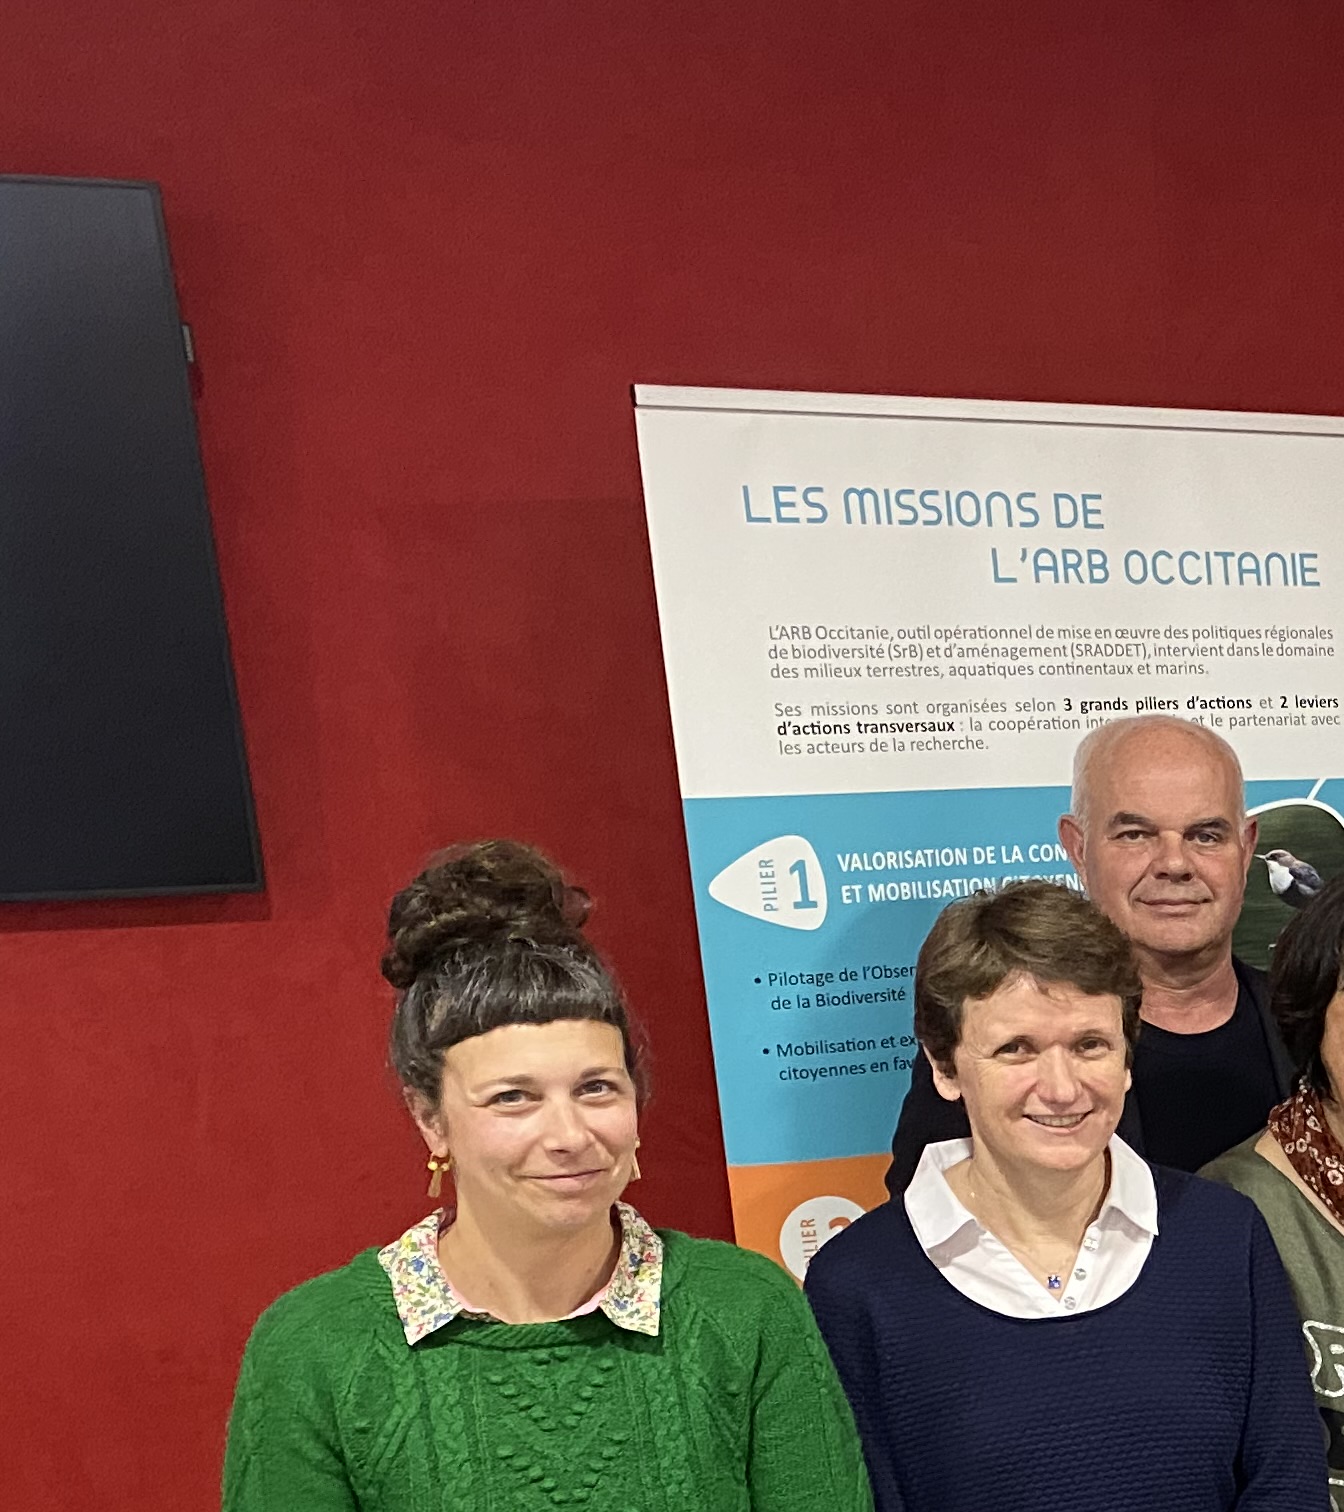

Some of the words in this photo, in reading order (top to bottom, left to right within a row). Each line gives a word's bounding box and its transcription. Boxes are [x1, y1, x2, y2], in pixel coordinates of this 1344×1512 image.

[742, 485, 828, 524] LES
[843, 487, 1040, 528] MISSIONS
[1053, 493, 1105, 529] DE
[1124, 549, 1321, 587] OCCITANIE
[815, 625, 894, 642] Occitanie,
[897, 626, 931, 640] outil
[934, 625, 1033, 643] opérationnel
[1035, 625, 1055, 640] de
[1057, 626, 1092, 640] mise
[1094, 628, 1113, 640] en
[1115, 628, 1161, 640] œuvre
[1164, 625, 1189, 640] des
[1192, 625, 1262, 643] politiques
[1264, 625, 1334, 643] régionales
[768, 644, 789, 660] de
[791, 644, 885, 660] biodiversité
[887, 643, 923, 662] (SrB)
[926, 645, 941, 659] et
[1070, 642, 1151, 660] (SRADDET),
[1154, 643, 1225, 658] intervient
[1227, 642, 1260, 658] dans
[1262, 642, 1274, 658] le
[1276, 642, 1335, 658] domaine
[770, 663, 799, 679] des
[804, 663, 862, 679] milieux
[867, 664, 945, 680] terrestres,
[948, 663, 1034, 680] aquatiques
[1038, 661, 1134, 676] continentaux
[1137, 662, 1151, 675] et
[1155, 661, 1210, 676] marins.
[774, 702, 801, 717] Ses
[810, 701, 878, 717] missions
[886, 701, 919, 715] sont
[926, 698, 1007, 717] organisées
[1015, 697, 1056, 713] selon
[1063, 698, 1073, 711] 3
[1080, 697, 1129, 714] grands
[1135, 695, 1179, 713] piliers
[1259, 697, 1274, 709] et
[1279, 695, 1289, 708] 2
[1294, 694, 1339, 709] leviers
[856, 719, 955, 734] transversaux
[968, 717, 983, 732] la
[988, 715, 1081, 734] coopération
[1210, 713, 1224, 728] le
[1229, 713, 1309, 730] partenariat
[1311, 714, 1341, 726] avec
[779, 740, 804, 756] les
[806, 738, 865, 754] acteurs
[869, 738, 889, 753] de
[892, 737, 906, 752] la
[910, 735, 989, 752] recherche.
[836, 847, 969, 873] VALORISATION
[973, 846, 996, 866] DE
[1001, 845, 1024, 864] LA
[759, 858, 778, 912] PILIER
[789, 859, 818, 910] 1
[840, 884, 862, 905] ET
[867, 877, 997, 903] MOBILISATION
[767, 971, 834, 988] Pilotage
[838, 967, 859, 982] de
[863, 964, 918, 981] l'Obser
[771, 996, 792, 1011] de
[797, 994, 811, 1010] la
[816, 986, 906, 1008] Biodiversité
[776, 1037, 876, 1058] Mobilisation
[880, 1034, 895, 1049] et
[779, 1061, 867, 1083] citoyennes
[870, 1059, 889, 1073] en
[893, 1056, 915, 1071] fav
